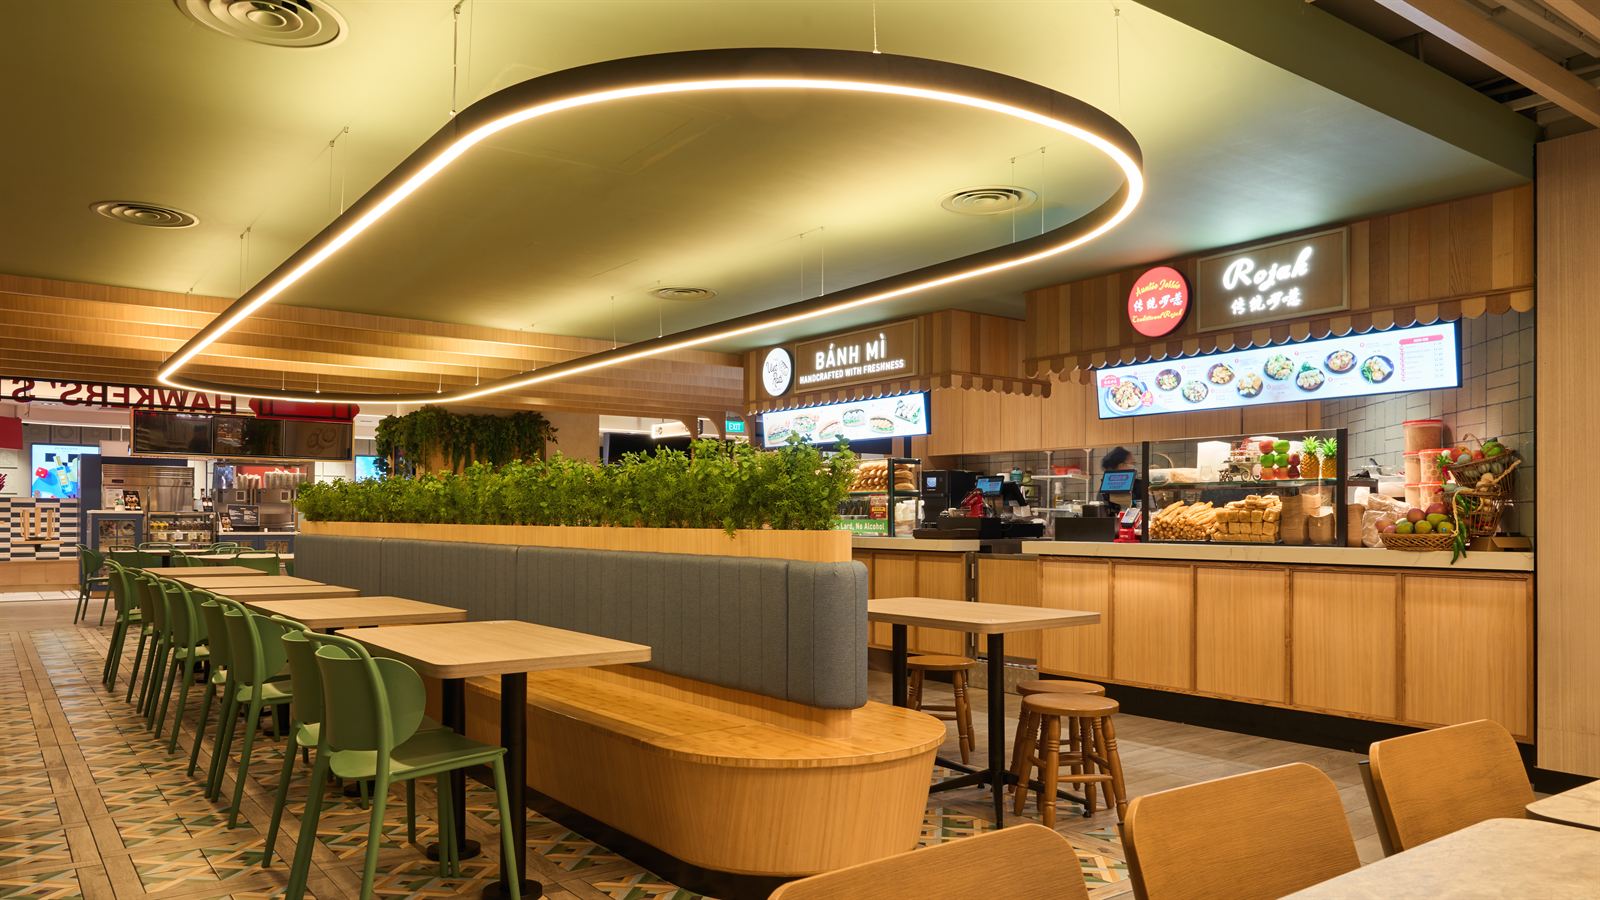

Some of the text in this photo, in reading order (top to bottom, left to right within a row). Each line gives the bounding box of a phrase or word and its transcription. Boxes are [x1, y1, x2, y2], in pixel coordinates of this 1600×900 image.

[1222, 246, 1312, 292] Rojak
[815, 333, 887, 370] BÁNH MÌ
[799, 358, 905, 385] HANDCRAFTED WITH FRESHNESS
[728, 423, 741, 431] EXIT
[855, 522, 863, 530] No
[864, 522, 885, 530] Alcohol
